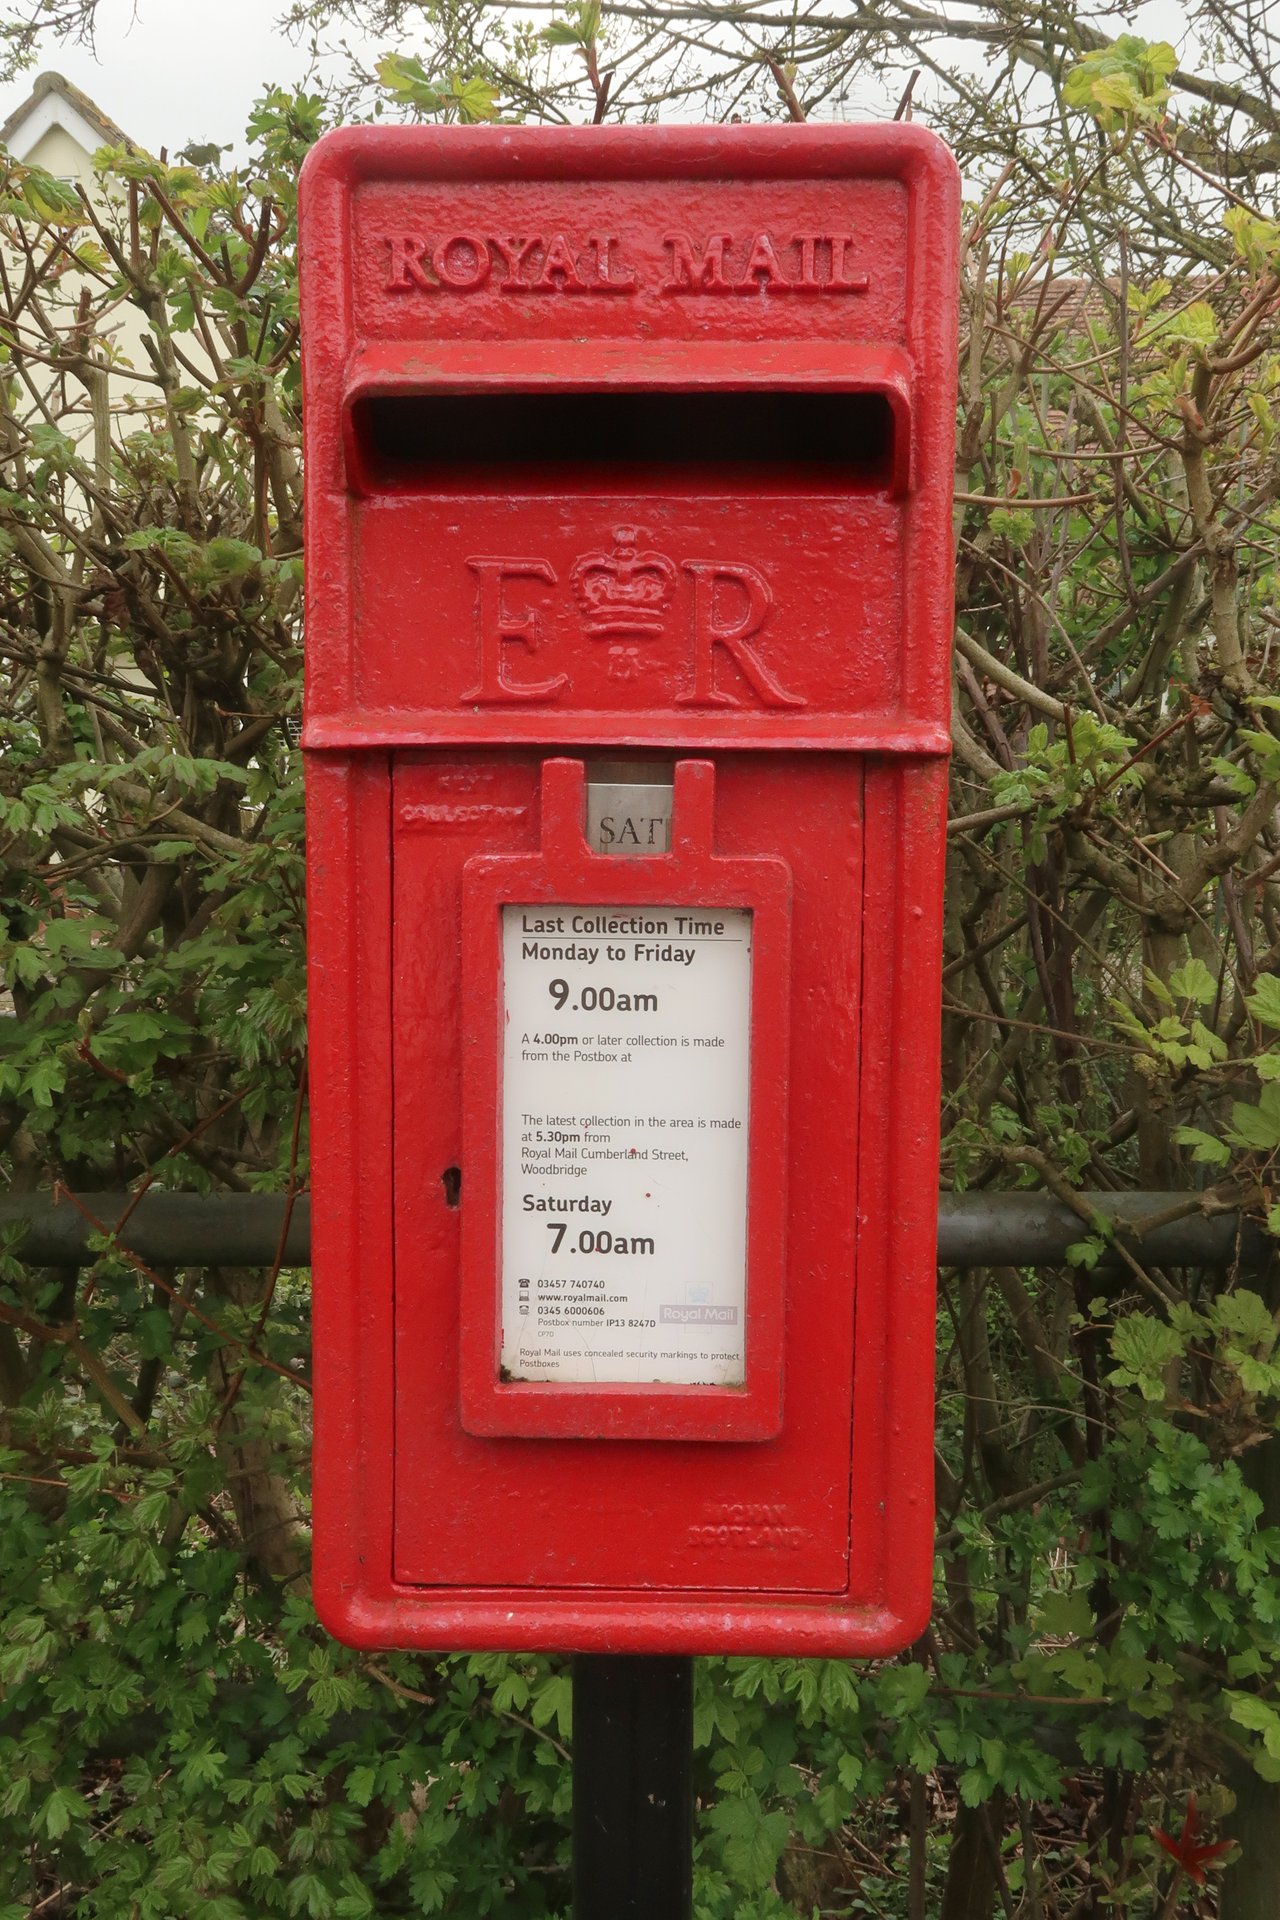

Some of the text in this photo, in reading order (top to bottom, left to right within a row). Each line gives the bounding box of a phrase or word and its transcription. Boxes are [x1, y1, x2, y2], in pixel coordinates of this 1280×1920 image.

[384, 232, 870, 293] ROYAL MAIL
[599, 816, 663, 845] SAT
[522, 915, 725, 935] Last Collection Time
[522, 943, 695, 965] Monday to Friday
[548, 978, 658, 1012] 9.00am
[522, 1034, 725, 1047] A 4.00pm or later collection is made
[522, 1051, 632, 1062] from the Postbox at
[521, 1115, 542, 1125] The
[546, 1115, 576, 1126] latest
[580, 1116, 630, 1127] collection
[635, 1116, 644, 1127] in
[648, 1117, 666, 1127] the
[698, 1118, 706, 1128] is
[710, 1118, 741, 1129] made
[521, 1131, 610, 1144] at 5.30pm from
[521, 1147, 689, 1161] Royal Mail Cumberland Street,
[521, 1164, 587, 1177] Woodbridge
[522, 1194, 612, 1216] Saturday
[547, 1223, 655, 1255] 7.00am
[538, 1280, 605, 1288] 03457 740740
[538, 1294, 628, 1303] www.royalmail.com
[564, 1307, 605, 1315] 6000606
[664, 1308, 733, 1321] Royal Mail
[628, 1319, 656, 1328] 8247D
[520, 1348, 541, 1357] Royal
[584, 1350, 623, 1358] concealed
[626, 1350, 657, 1359] security
[661, 1352, 697, 1360] markings
[520, 1360, 560, 1368] Postboxes
